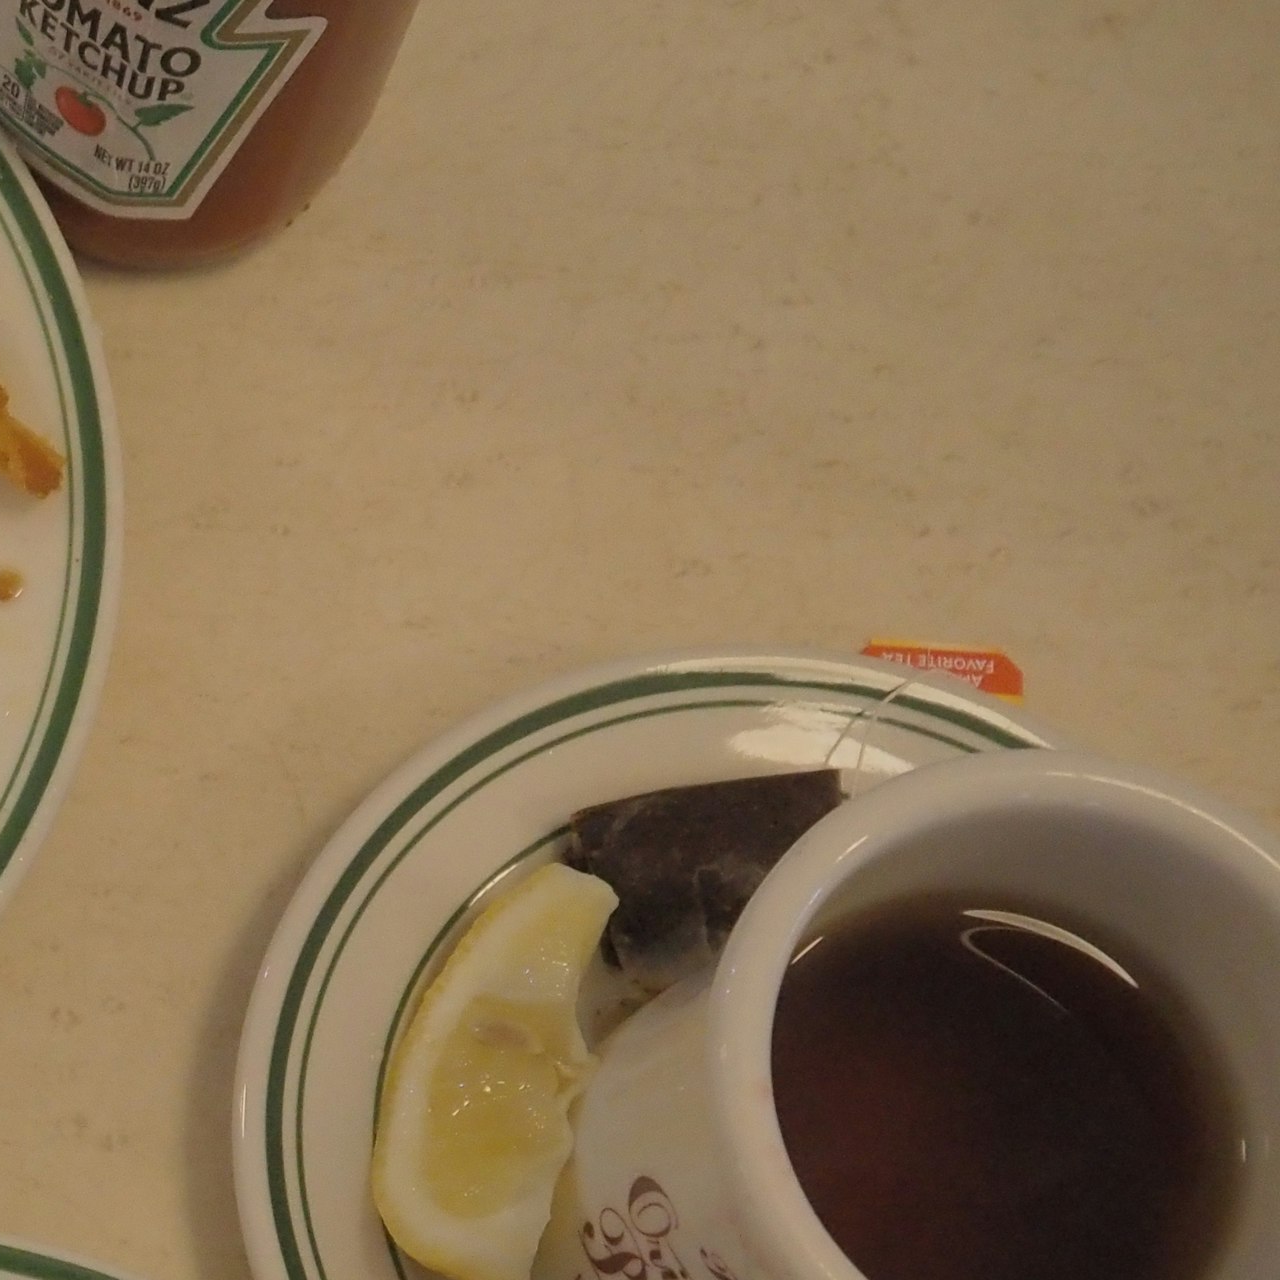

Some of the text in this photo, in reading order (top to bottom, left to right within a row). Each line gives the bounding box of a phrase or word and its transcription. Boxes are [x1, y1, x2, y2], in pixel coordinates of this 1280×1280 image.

[2, 73, 20, 98] 20
[115, 158, 135, 172] WT
[138, 161, 150, 173] 14
[153, 162, 171, 175] OZ
